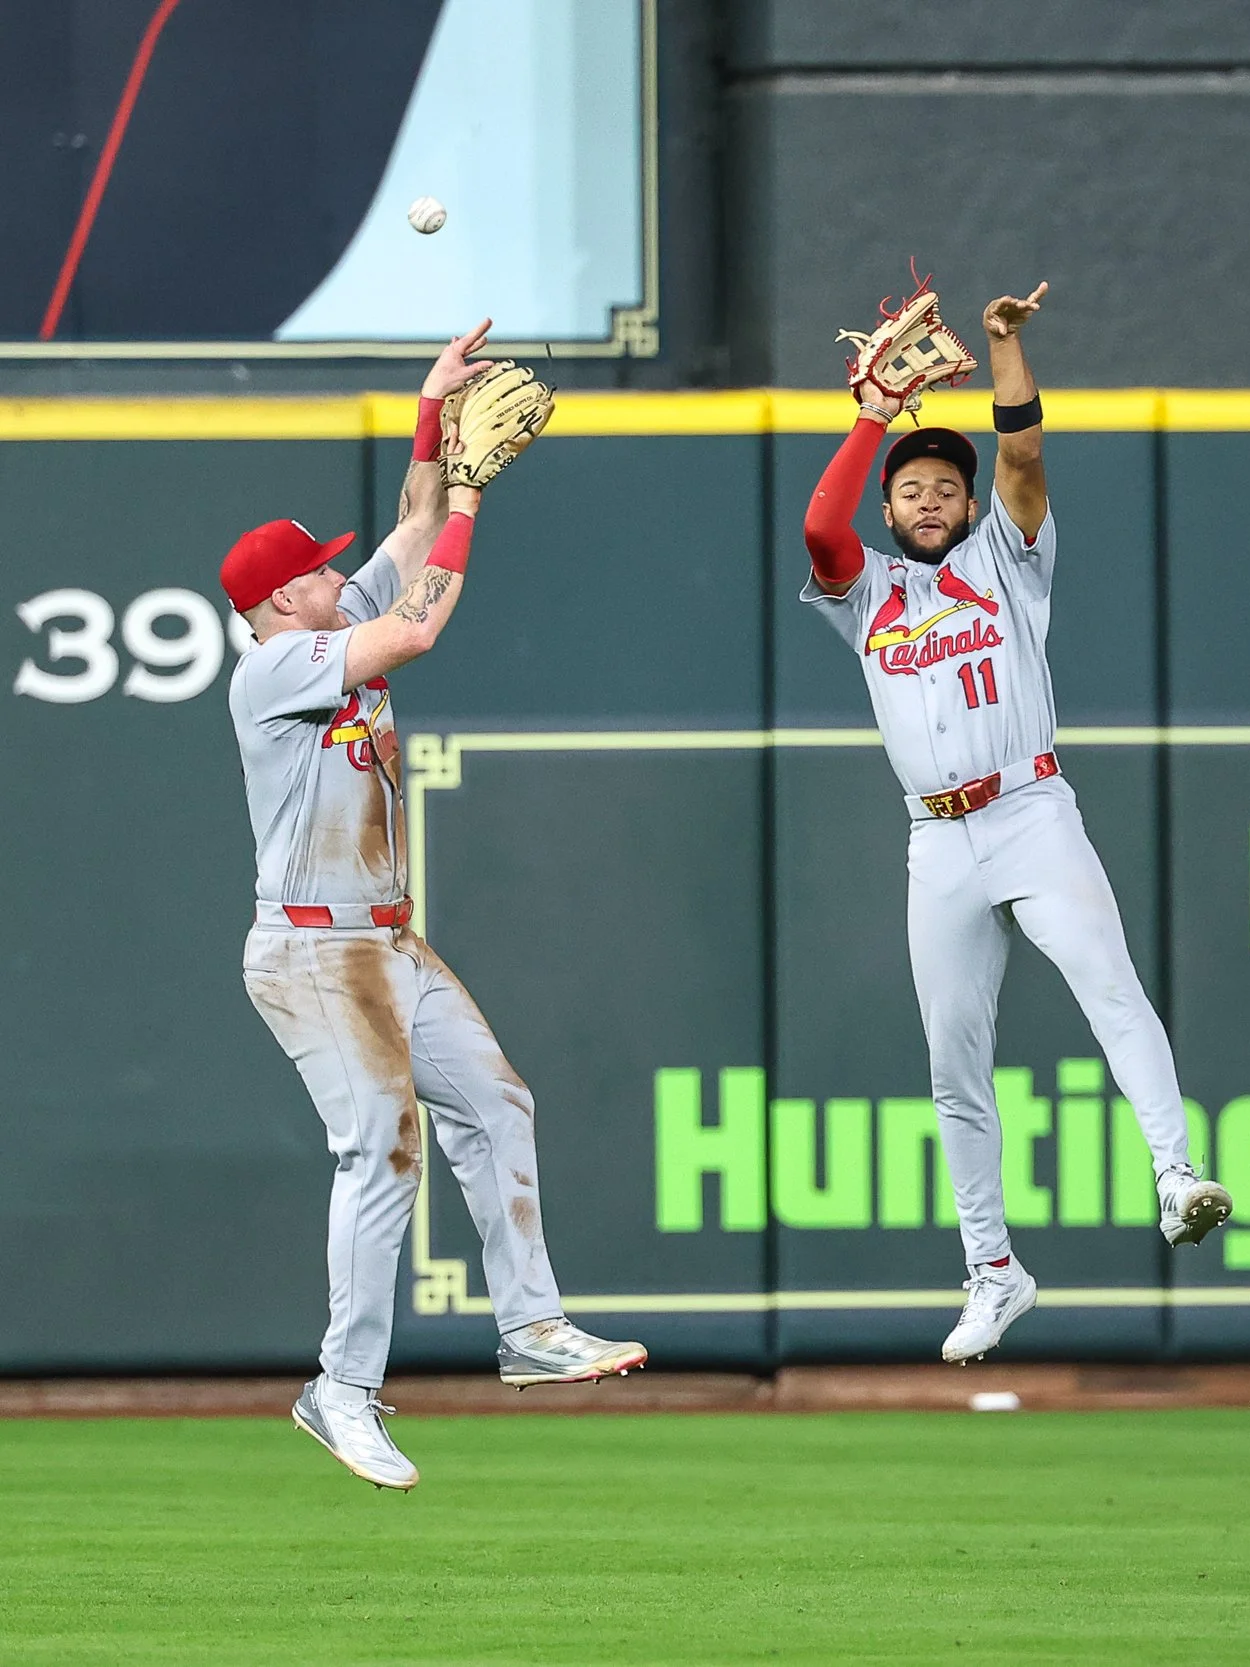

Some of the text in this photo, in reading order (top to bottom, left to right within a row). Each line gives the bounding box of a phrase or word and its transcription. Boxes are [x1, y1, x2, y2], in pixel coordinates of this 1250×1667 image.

[13, 587, 255, 703] 39
[310, 631, 331, 664] STIF
[957, 657, 1000, 710] 11
